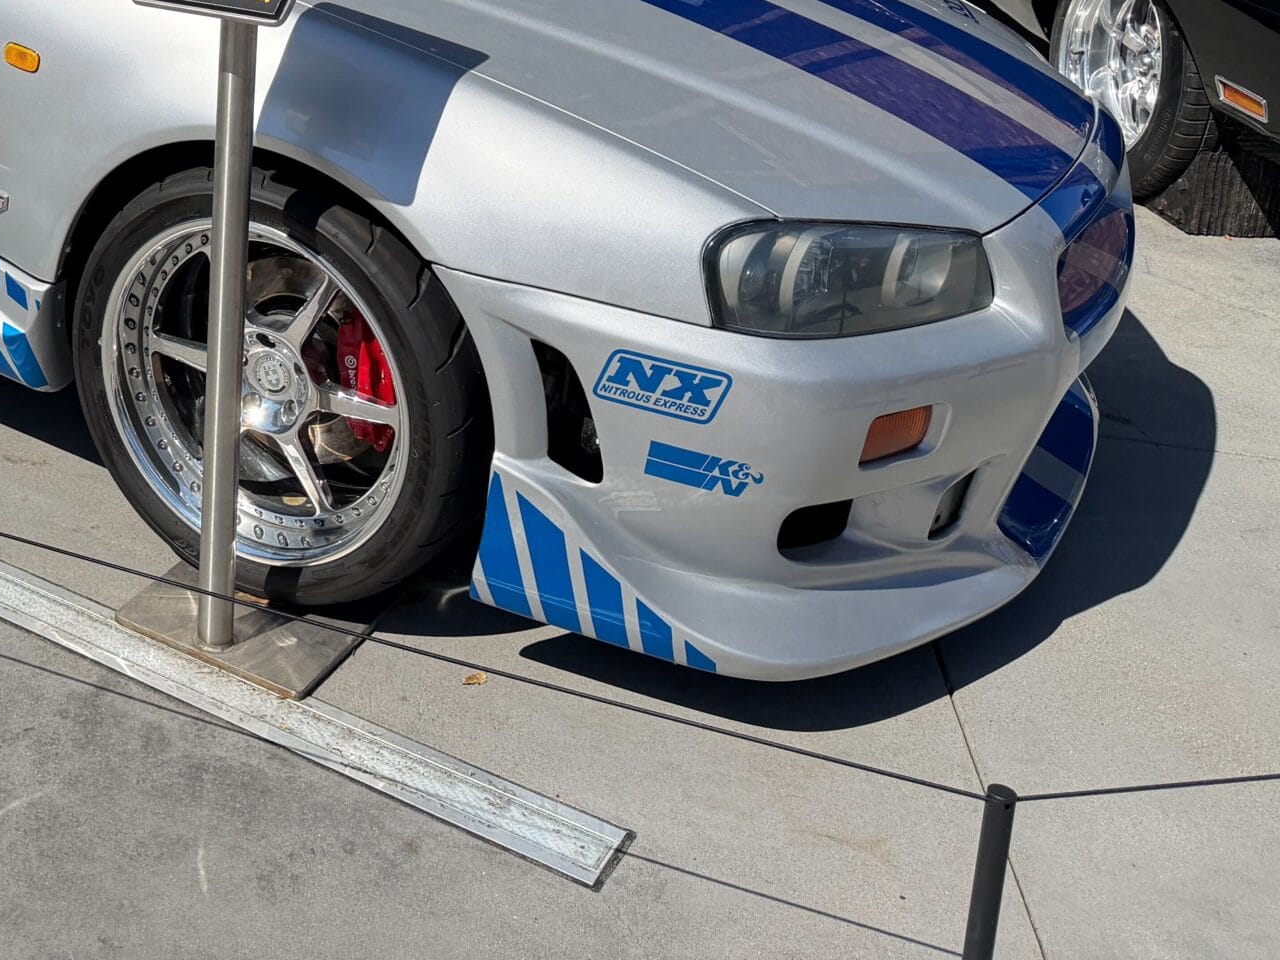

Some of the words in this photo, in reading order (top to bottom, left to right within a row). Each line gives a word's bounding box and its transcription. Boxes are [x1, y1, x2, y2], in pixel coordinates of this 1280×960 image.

[599, 382, 652, 405] NITROUS
[652, 397, 708, 418] EXPRESS
[605, 355, 724, 407] NX
[701, 455, 765, 498] K&N
